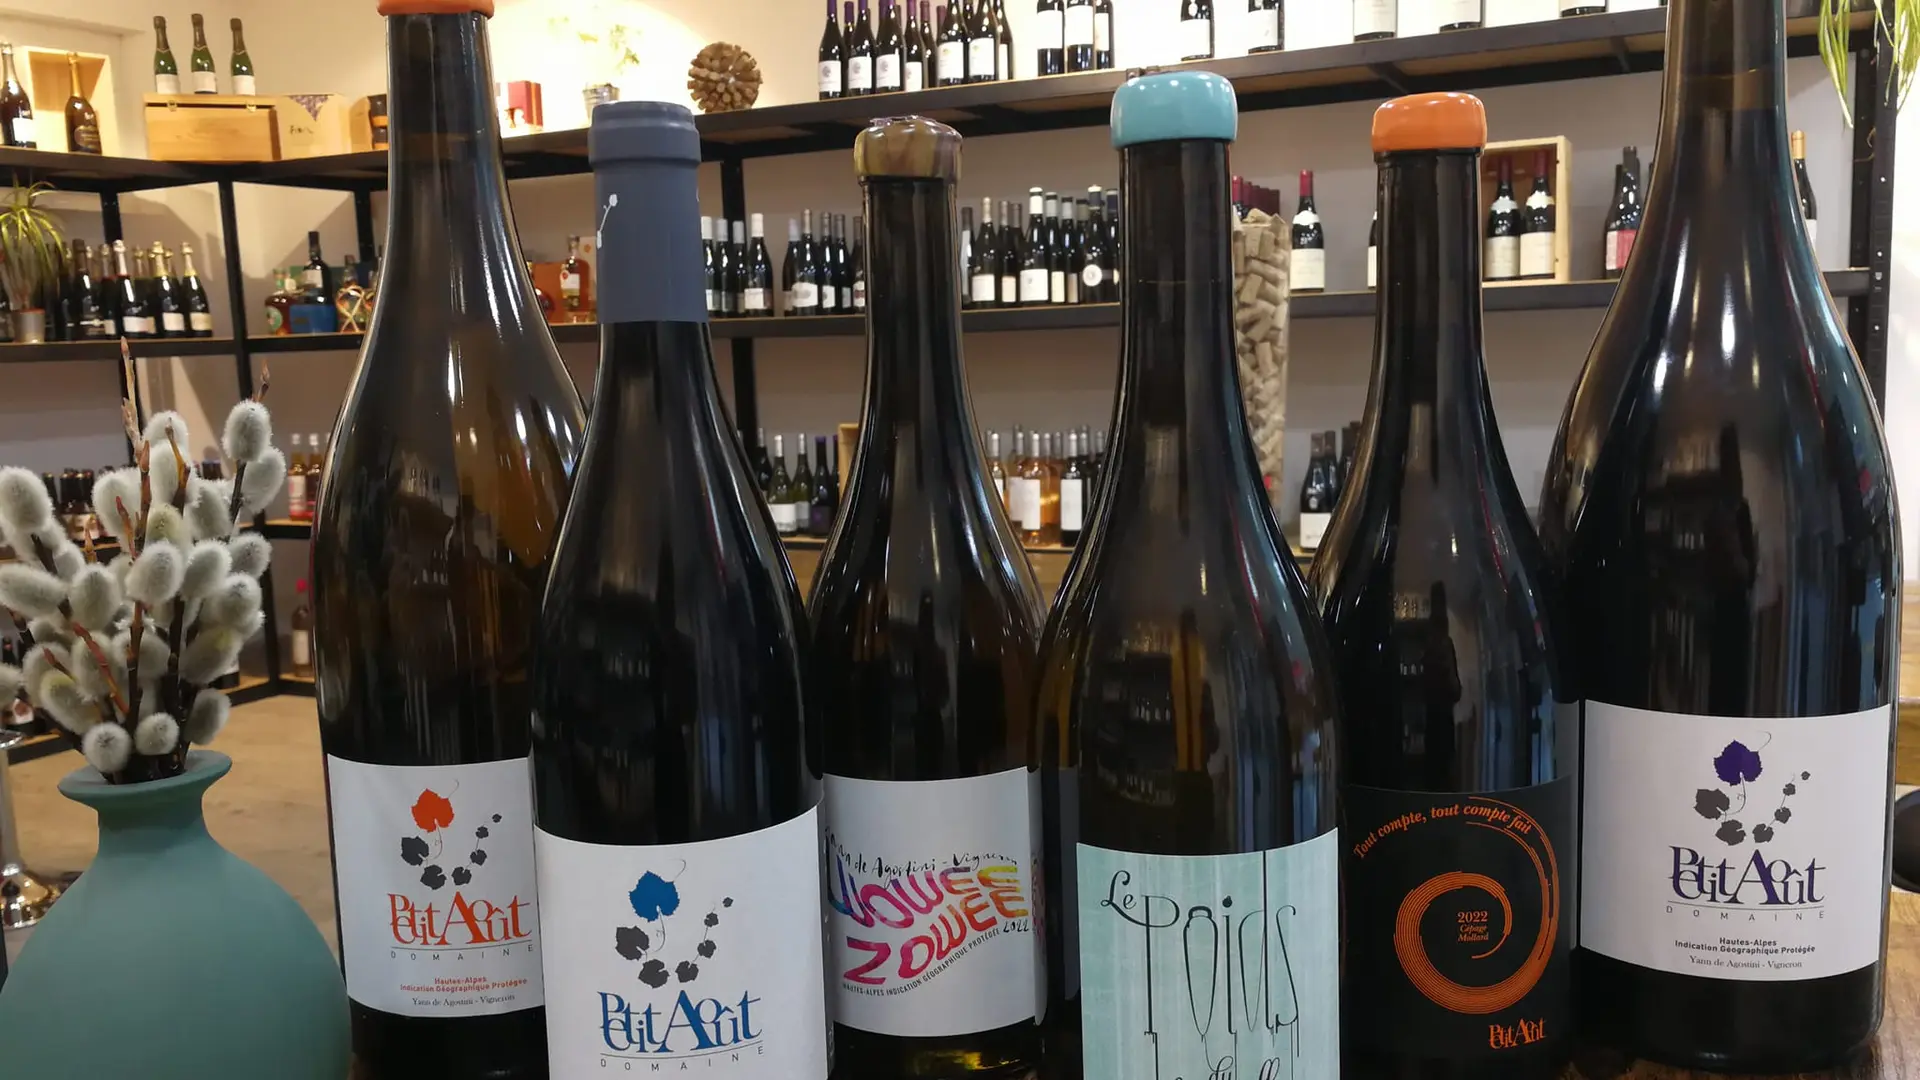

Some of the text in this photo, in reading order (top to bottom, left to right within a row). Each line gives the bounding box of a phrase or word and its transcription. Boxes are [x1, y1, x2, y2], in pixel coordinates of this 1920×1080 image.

[1353, 803, 1534, 859] Tout compte, tout compte fait
[854, 853, 868, 873] de
[825, 836, 1021, 929] WOWEE
[1100, 869, 1138, 914] Le
[1457, 911, 1488, 923] 2022
[1665, 905, 1825, 922] DOMAINE
[1002, 918, 1031, 933] 2022
[843, 886, 1029, 986] ZOWEE
[1719, 937, 1777, 948] Hautes-Alpes
[390, 943, 534, 961] DOMAINE
[1674, 939, 1816, 955] Indication Géographique Protégée
[1688, 955, 1712, 966] Yann
[1713, 958, 1725, 966] de
[1726, 959, 1760, 969] Agostini
[1767, 960, 1803, 970] Vigneron
[400, 983, 435, 992] Indication
[435, 983, 490, 994] Géographique
[434, 976, 487, 986] Hautes-Alpes
[842, 981, 885, 997] HAUTES-ALPES
[886, 978, 923, 997] INDICATION
[601, 1045, 765, 1072] DOMAINE
